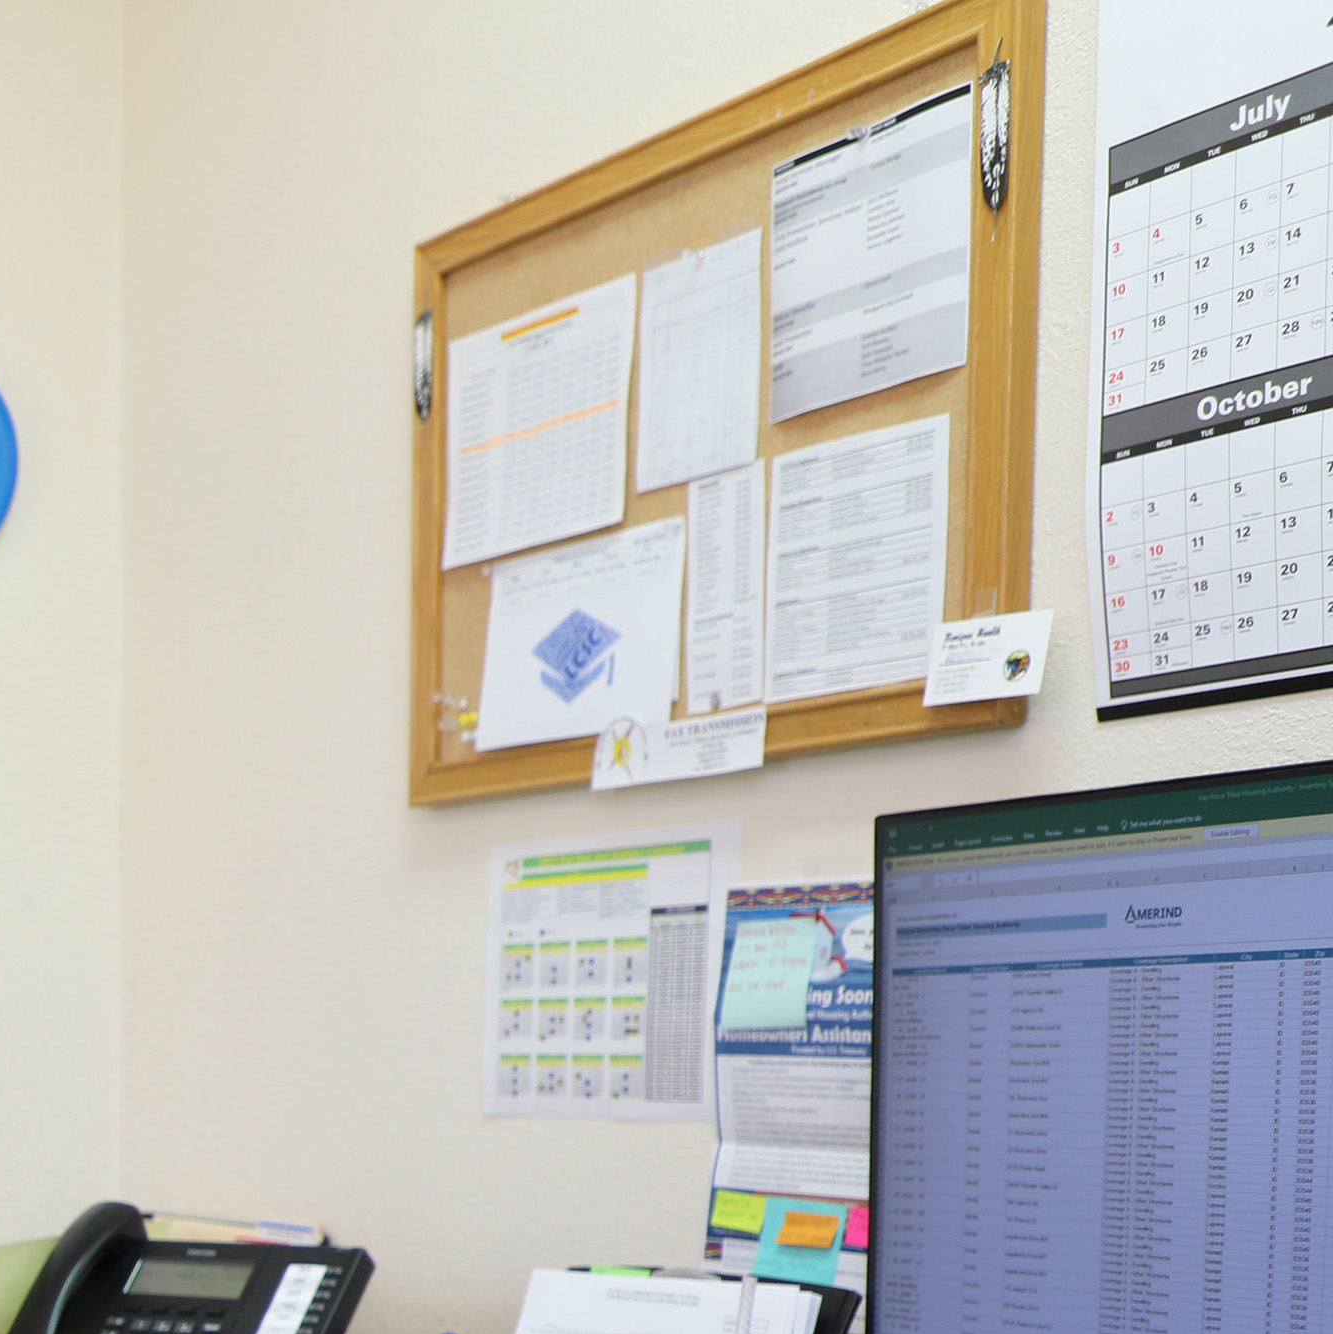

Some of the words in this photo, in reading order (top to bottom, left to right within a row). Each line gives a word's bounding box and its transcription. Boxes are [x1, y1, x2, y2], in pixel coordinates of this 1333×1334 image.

[1229, 94, 1291, 132] July
[1163, 162, 1180, 174] MON
[1207, 147, 1221, 158] TUE
[1251, 130, 1268, 142] WED
[1299, 113, 1315, 124] THU
[1113, 242, 1120, 253] 3
[1152, 228, 1160, 239] 4
[1195, 214, 1203, 225] 5
[1240, 199, 1248, 210] 6
[1286, 183, 1295, 195] 7
[1112, 284, 1126, 297] 10
[1152, 272, 1165, 284] 11
[1194, 257, 1210, 270] 12
[1239, 243, 1255, 255] 13
[1285, 228, 1301, 240] 14
[1111, 328, 1124, 340] 17
[1151, 316, 1166, 327] 18
[1194, 303, 1209, 315] 19
[1236, 289, 1254, 302] 20
[1283, 275, 1300, 288] 21
[1108, 371, 1123, 383] 24
[1150, 360, 1165, 372] 25
[1192, 347, 1208, 360] 26
[1236, 334, 1252, 347] 27
[1281, 321, 1300, 335] 28
[1108, 394, 1123, 406] 31
[1196, 375, 1312, 421] October
[1156, 439, 1172, 449] MON
[1200, 428, 1214, 437] TUE
[1244, 417, 1260, 426] WED
[1291, 405, 1307, 415] THU
[1106, 512, 1114, 522] 2
[1148, 502, 1155, 513] 3
[1190, 492, 1198, 503] 4
[1234, 483, 1242, 494] 5
[1279, 472, 1287, 483] 6
[1108, 555, 1115, 566] 9
[1150, 545, 1163, 556] 10
[1191, 537, 1205, 548] 11
[1235, 526, 1250, 538] 12
[1281, 516, 1297, 529] 13
[1111, 597, 1125, 608] 16
[1151, 589, 1165, 600] 17
[1193, 581, 1208, 592] 18
[1236, 571, 1252, 584] 19
[1281, 563, 1298, 575] 20
[1114, 638, 1128, 650] 23
[1154, 632, 1169, 643] 24
[1195, 624, 1211, 636] 25
[1238, 616, 1254, 629] 26
[1282, 608, 1298, 621] 27
[1115, 660, 1130, 672] 30
[1155, 654, 1169, 666] 31
[1163, 819, 1172, 827] you
[1211, 829, 1228, 838] Enable
[1230, 828, 1250, 837] Editing
[1124, 905, 1182, 921] AMERIND
[1240, 953, 1253, 961] City
